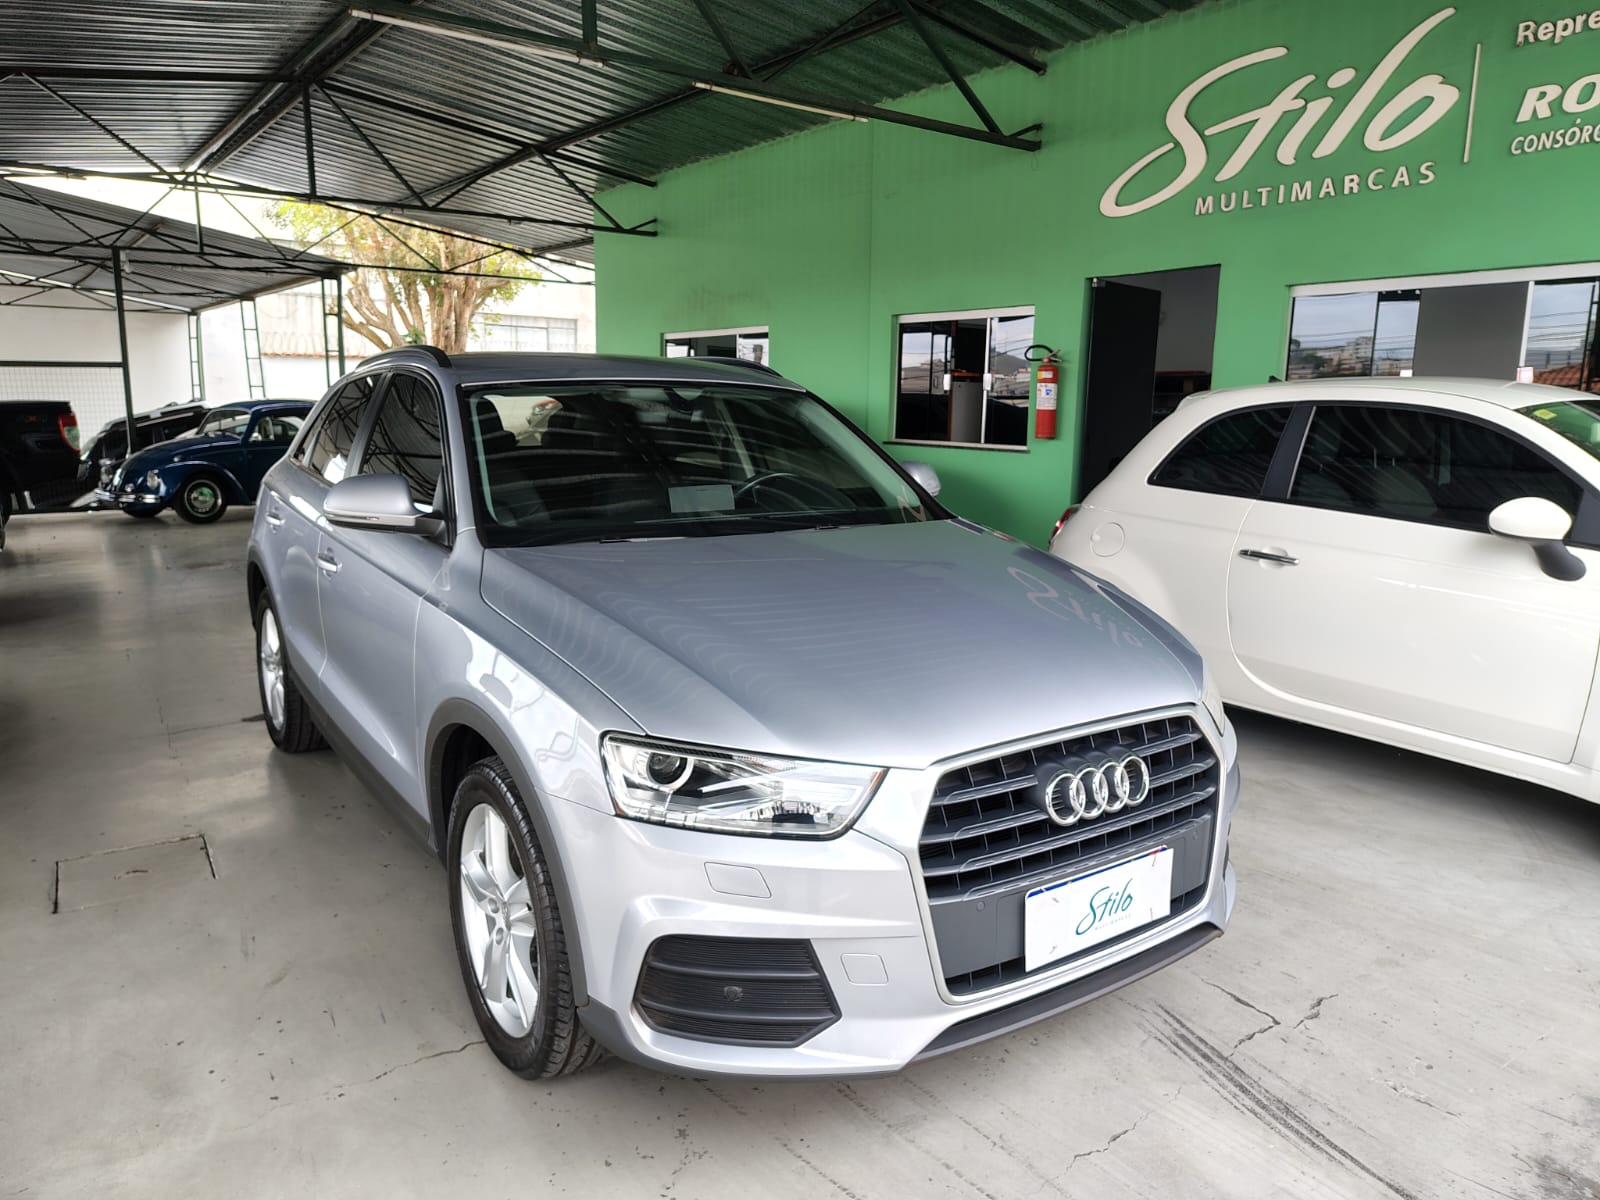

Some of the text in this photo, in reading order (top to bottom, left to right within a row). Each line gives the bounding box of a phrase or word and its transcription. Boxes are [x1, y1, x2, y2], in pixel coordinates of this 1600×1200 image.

[1516, 10, 1600, 46] Repre
[1099, 7, 1461, 218] Stilo
[1516, 73, 1600, 123] RO
[1195, 161, 1436, 215] MULTIMARCAS
[1075, 877, 1133, 935] Stilo
